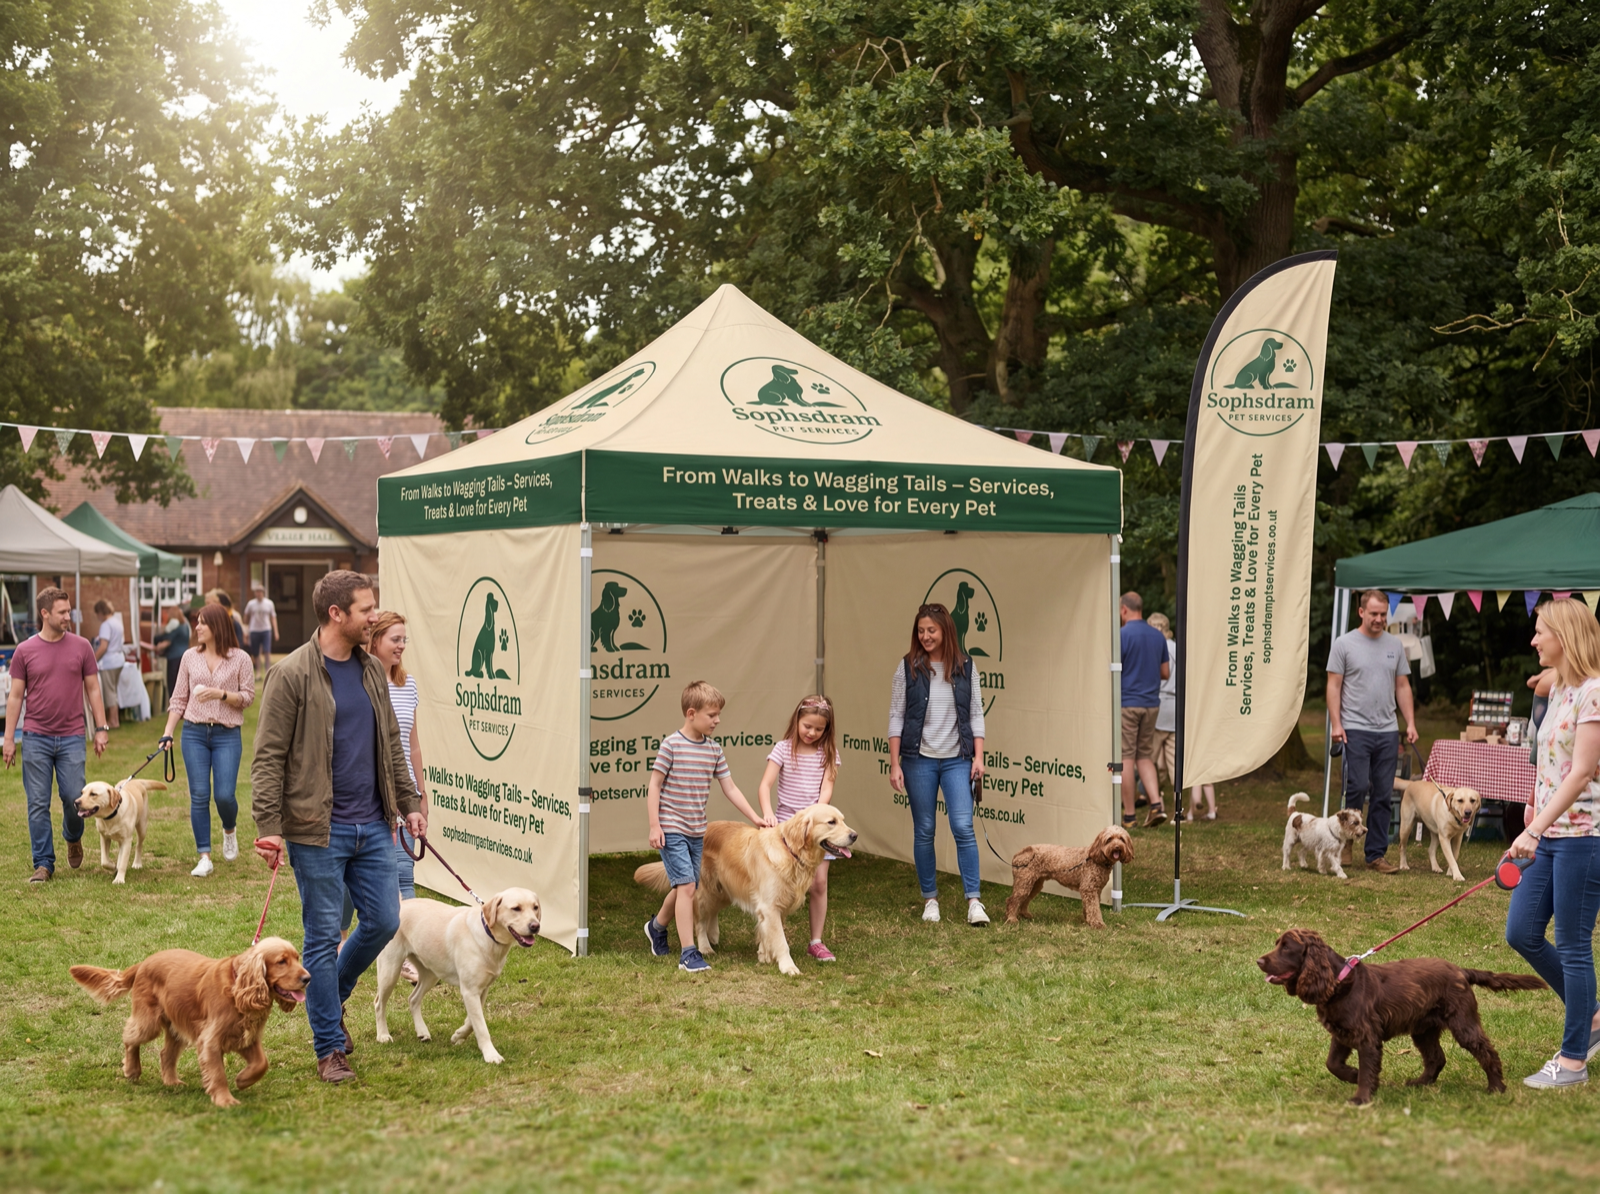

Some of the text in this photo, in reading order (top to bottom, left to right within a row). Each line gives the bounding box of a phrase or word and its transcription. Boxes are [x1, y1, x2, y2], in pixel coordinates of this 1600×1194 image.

[1207, 392, 1315, 412] Sophsdram
[731, 407, 882, 426] Sophsdram
[1228, 413, 1292, 422] PET SERVICES
[799, 426, 860, 435] SERVICES
[400, 487, 419, 501] From
[420, 483, 442, 499] Walks
[443, 483, 451, 496] to
[452, 478, 486, 499] Wagging
[487, 475, 505, 492] Tails
[513, 470, 553, 489] Services,
[662, 466, 716, 484] From
[722, 468, 783, 486] Walks
[788, 471, 809, 487] to
[814, 471, 899, 494] Wagging
[903, 474, 947, 492] Tails
[969, 477, 1054, 499] Services,
[423, 495, 528, 520] Treats & Love for Every Pet
[732, 492, 997, 519] Treats & Love for Every Pet
[1225, 484, 1248, 686] From Walks to Wagging Tails
[1239, 453, 1264, 716] Services, Treats & Love for Every Pet
[590, 657, 671, 680] sdram
[455, 682, 522, 716] Sophsdram
[592, 688, 645, 699] SERVICES
[469, 719, 509, 736] PET SERVICES
[589, 735, 637, 757] gging
[843, 733, 871, 752] From
[615, 757, 641, 773] for
[982, 751, 1010, 769] Tails
[1024, 755, 1086, 784] Services,
[428, 765, 454, 787] Walks
[455, 772, 464, 789] to
[465, 773, 501, 803] Wagging
[502, 782, 522, 804] Tails
[531, 788, 572, 821] Services,
[982, 774, 1044, 798] Every Pet
[432, 789, 545, 835] Treats & Love for Every Pet
